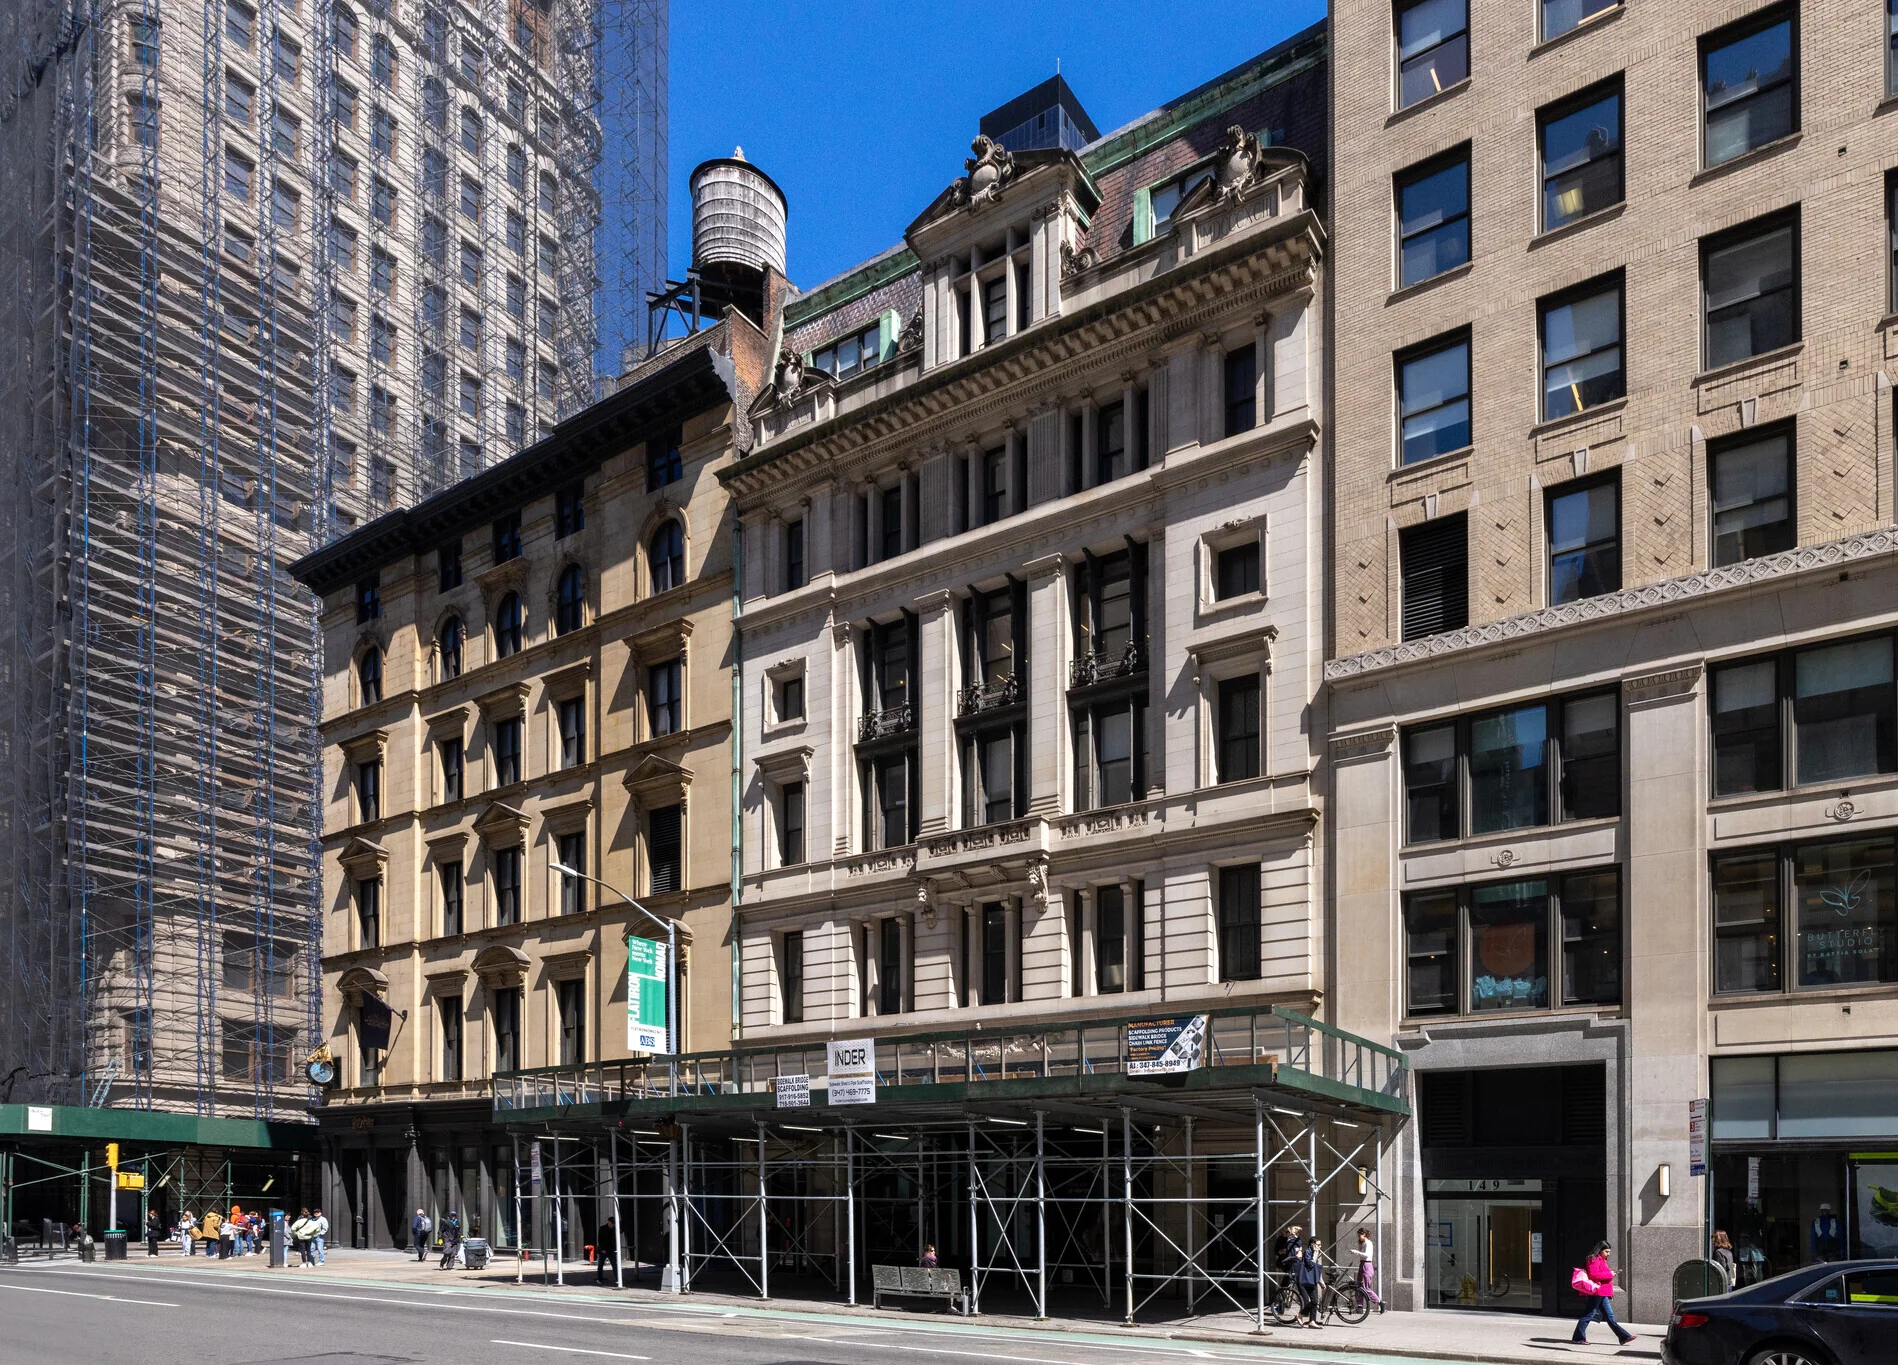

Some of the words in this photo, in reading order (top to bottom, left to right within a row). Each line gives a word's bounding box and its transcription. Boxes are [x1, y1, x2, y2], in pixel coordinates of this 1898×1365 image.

[1808, 927, 1884, 941] BUTTERFLY
[1820, 936, 1872, 949] STUDIO
[655, 942, 666, 982] NOMAD
[628, 972, 640, 1022] FLATIRON
[1128, 1020, 1175, 1028] MANUFACTURER
[834, 1049, 866, 1067] INDER
[1140, 1060, 1180, 1069] 347-845-8949
[777, 1077, 794, 1085] SIDEWALK
[778, 1084, 808, 1092] SCAFFOLDING
[832, 1089, 845, 1097] (347)
[1469, 1180, 1499, 1190] 149
